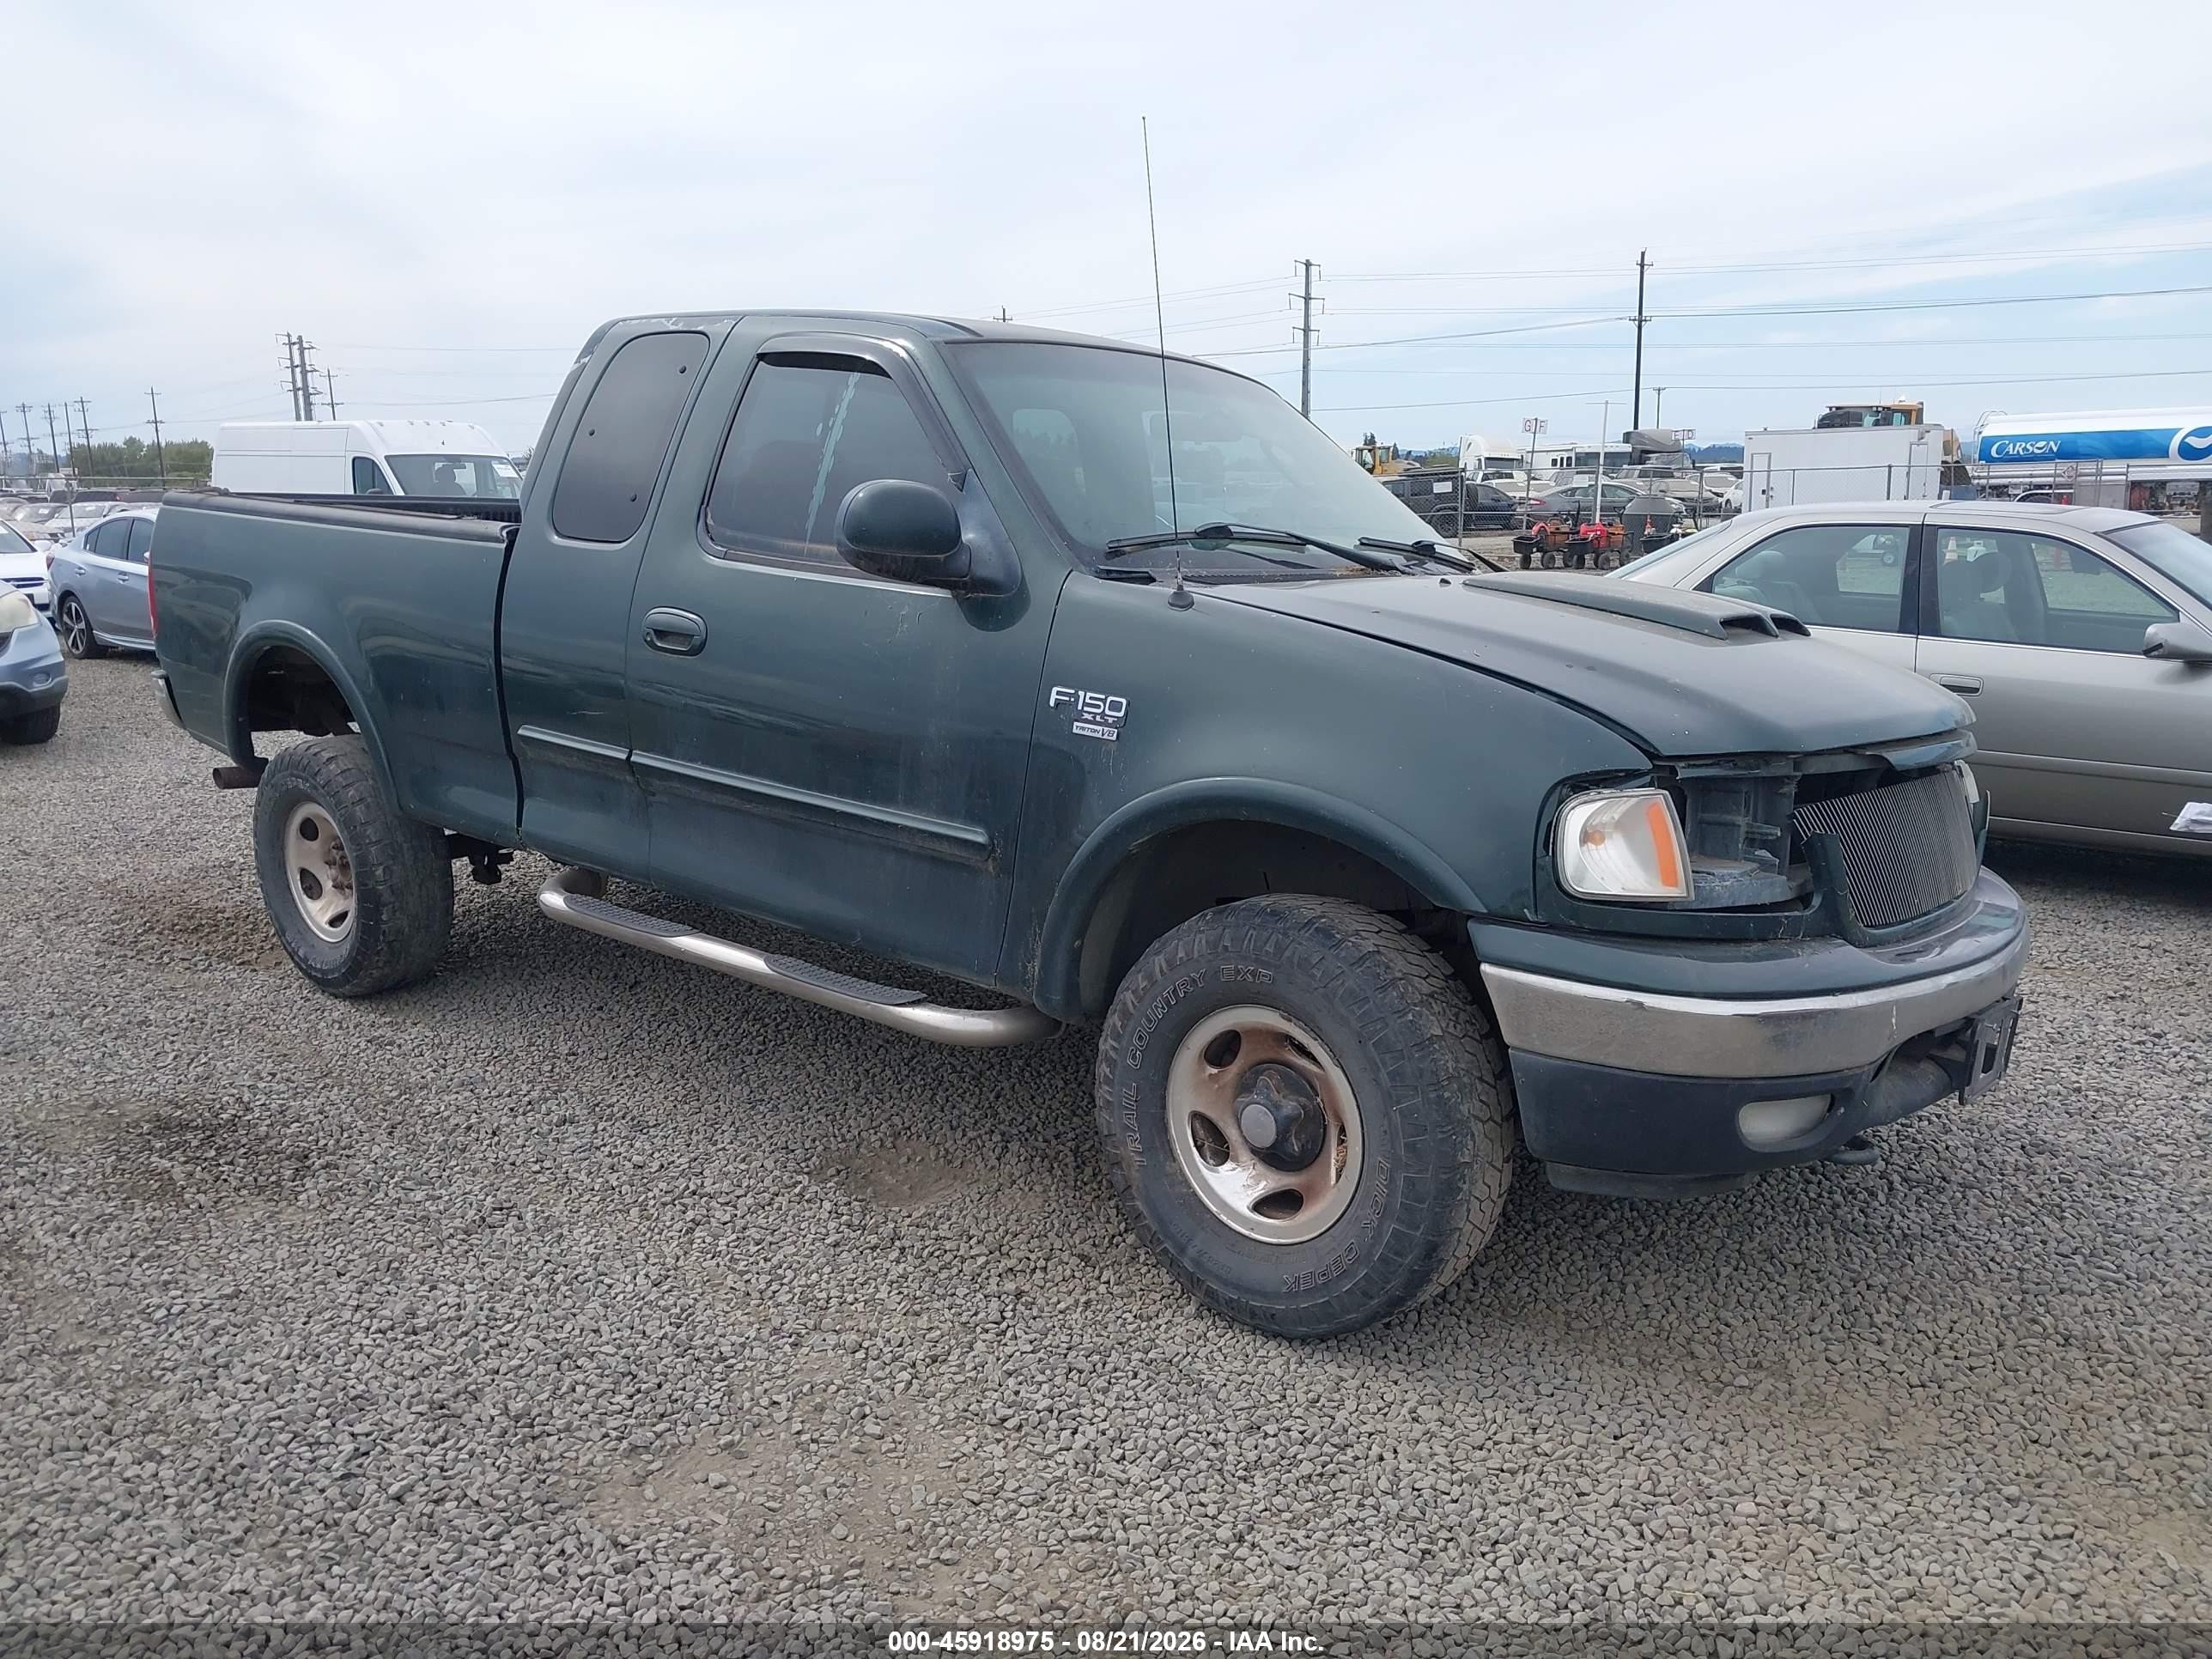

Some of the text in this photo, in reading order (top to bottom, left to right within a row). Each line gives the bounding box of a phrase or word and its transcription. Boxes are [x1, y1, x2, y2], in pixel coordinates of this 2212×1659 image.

[1524, 419, 1546, 433] G F
[1990, 440, 2061, 459] CARSON
[1082, 713, 1117, 724] XLT
[1074, 725, 1115, 738] TRITON V8
[1122, 964, 1273, 1165] TRAIL COUNTRY EXP
[1283, 1157, 1389, 1292] DICK CEPEK
